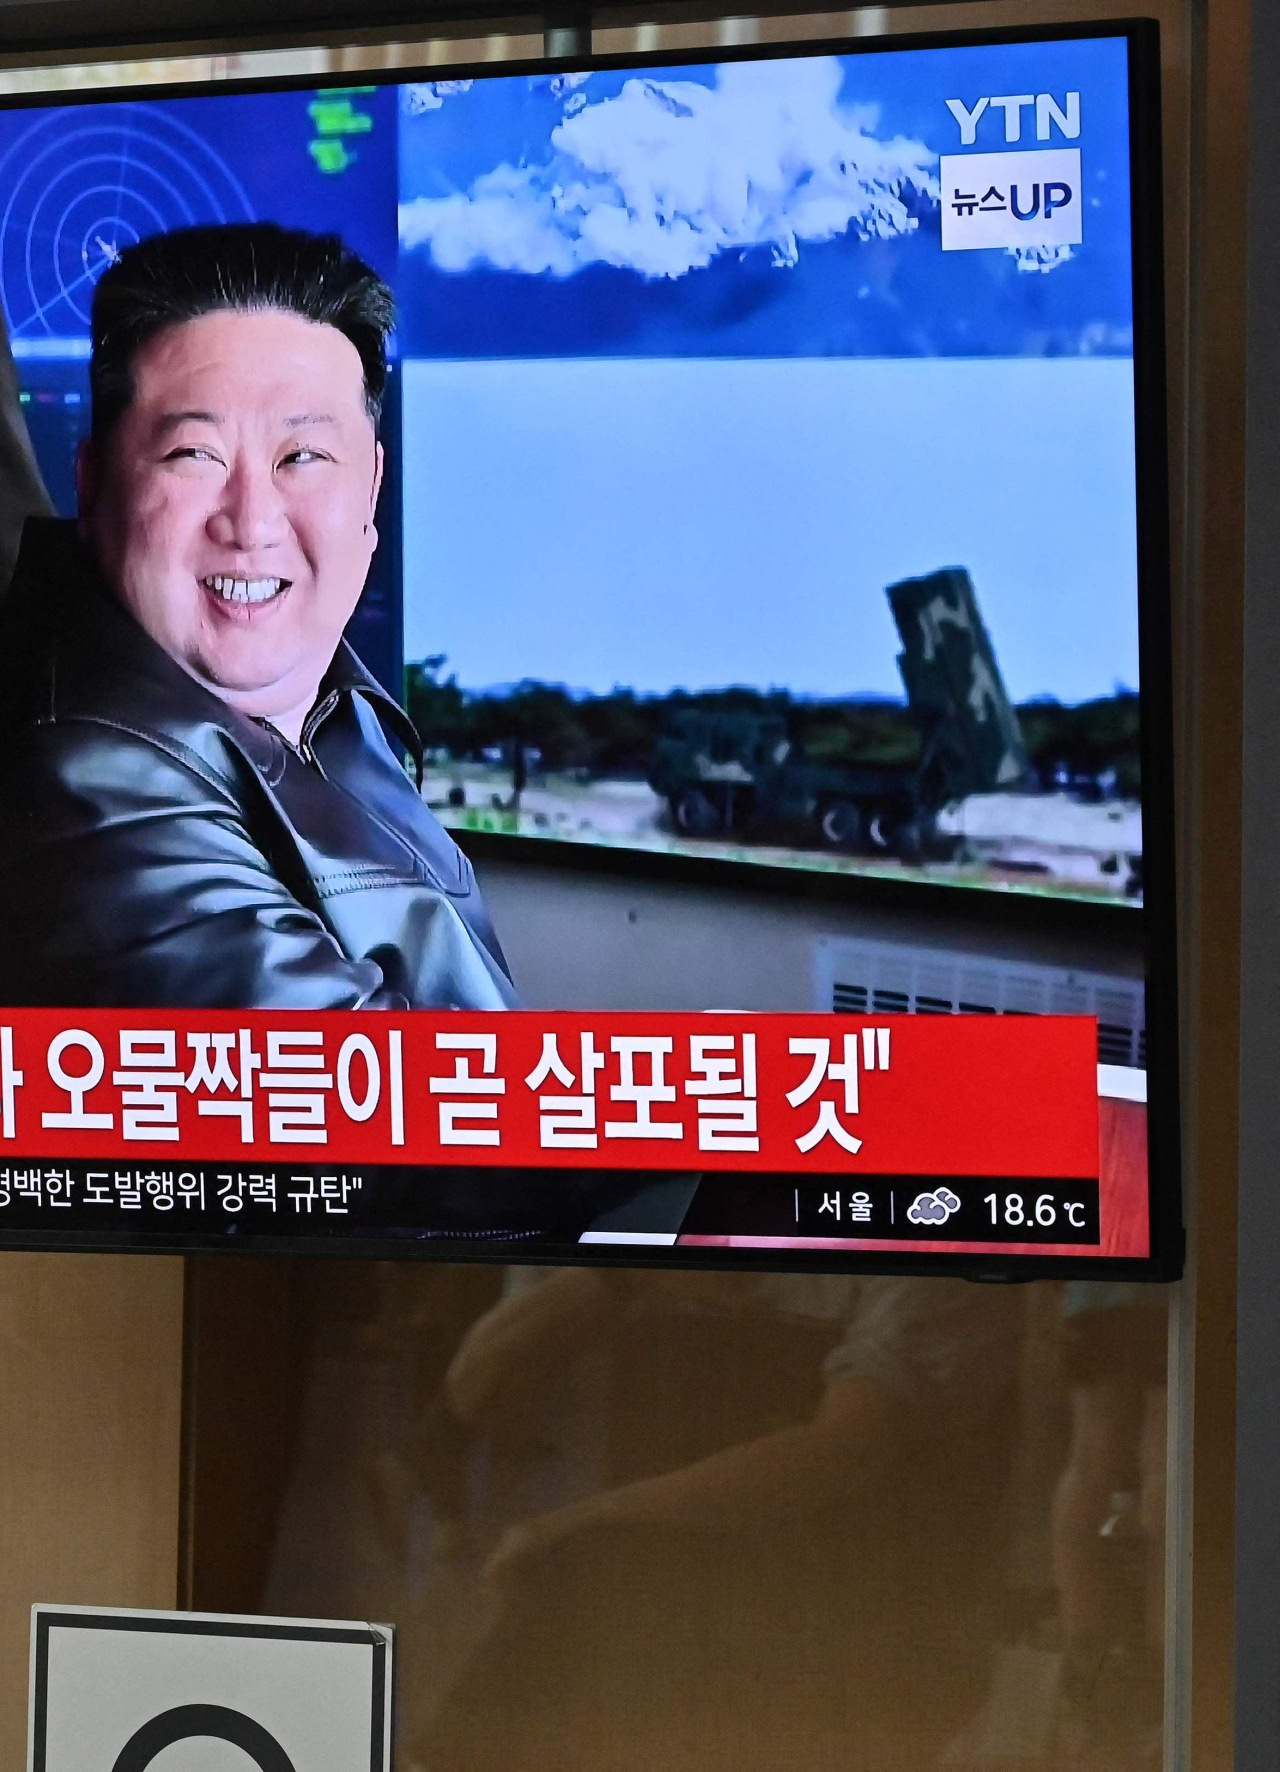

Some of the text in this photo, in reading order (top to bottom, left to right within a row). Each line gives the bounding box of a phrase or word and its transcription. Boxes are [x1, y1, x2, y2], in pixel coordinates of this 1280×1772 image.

[945, 91, 1081, 145] YTN
[41, 1028, 405, 1146] 오물짝들이
[429, 1032, 506, 1146] 곧
[524, 1031, 760, 1152] 살포될
[785, 1027, 891, 1154] 것"
[82, 1170, 205, 1211] 도발행위
[216, 1172, 277, 1213] 강력
[287, 1174, 362, 1214] 규탄"
